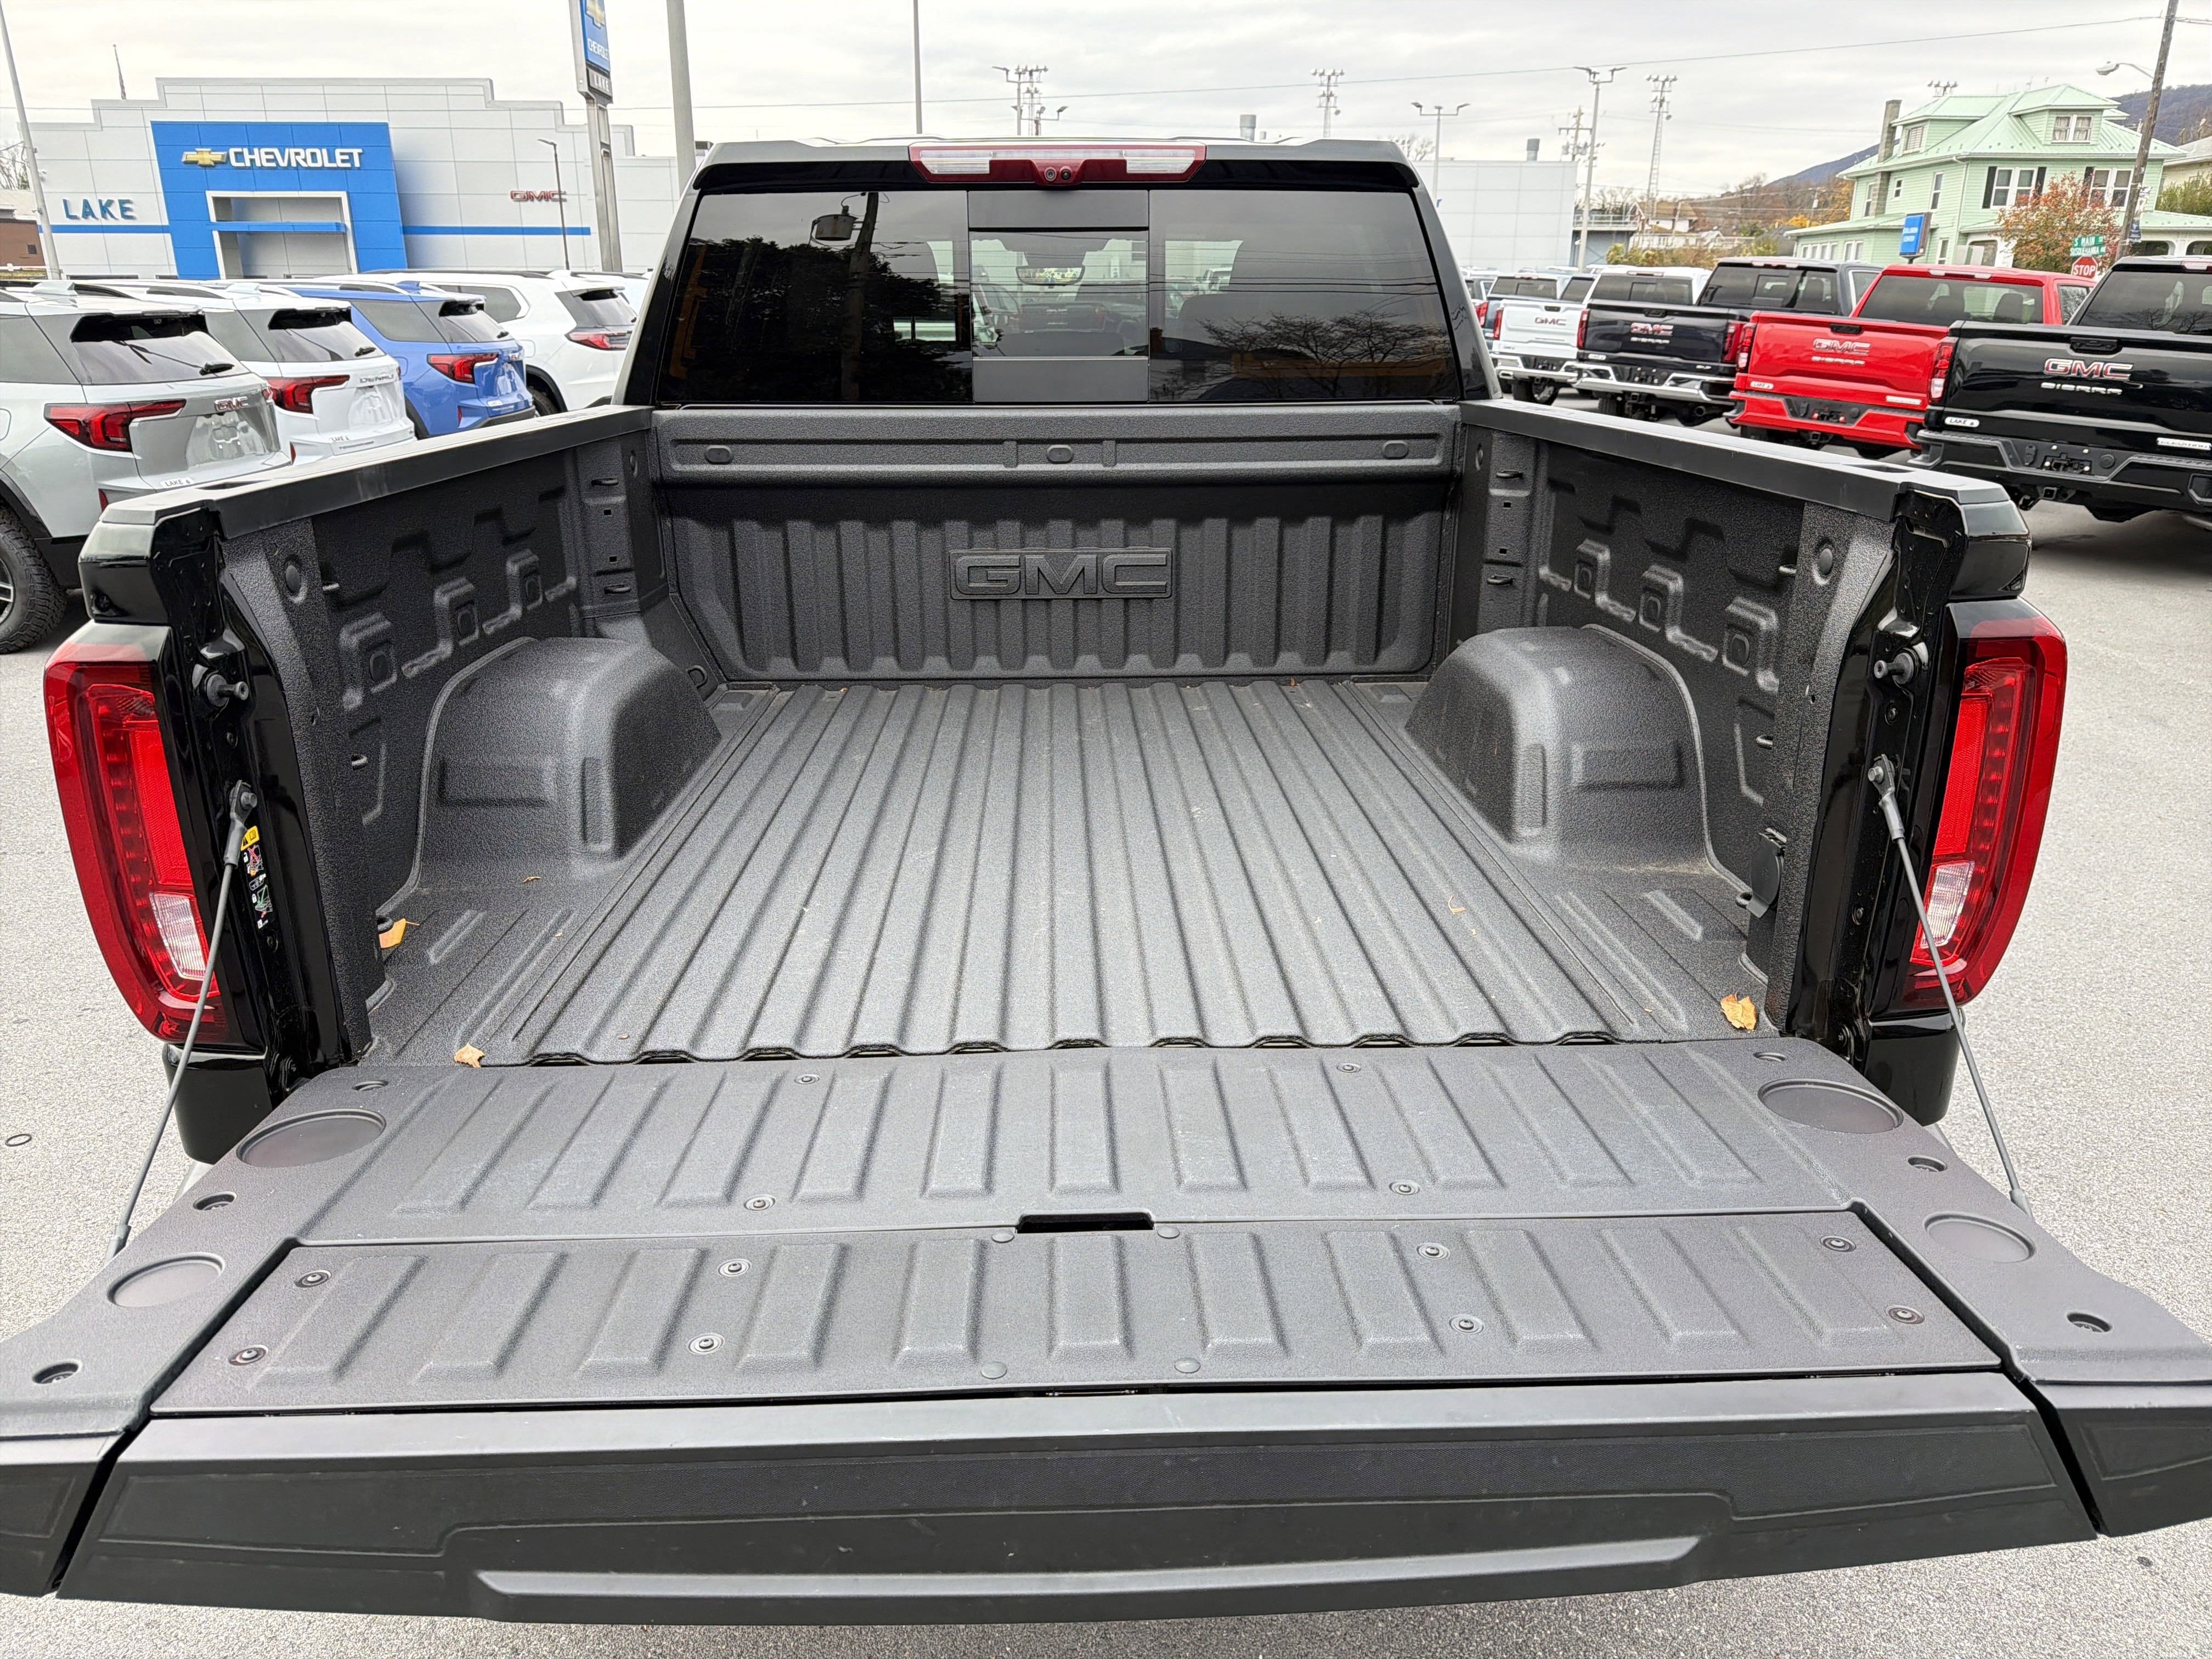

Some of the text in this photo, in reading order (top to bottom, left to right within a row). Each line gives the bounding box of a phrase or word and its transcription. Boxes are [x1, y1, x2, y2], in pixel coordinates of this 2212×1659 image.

[594, 74, 610, 93] LAKE
[229, 147, 363, 168] CHEVROLET
[510, 190, 567, 202] GMC
[62, 198, 137, 220] LAKE
[2074, 238, 2079, 246] S
[2081, 236, 2095, 245] MAIN
[2074, 264, 2096, 276] STOP
[1534, 317, 1567, 326] GMC
[1631, 322, 1673, 337] GMC
[1813, 337, 1871, 356] GMC
[2044, 358, 2134, 381] GMC
[360, 374, 393, 383] DENALI
[2040, 382, 2123, 396] SIERRA
[215, 396, 249, 412] GMC
[955, 554, 1169, 596] GMC
